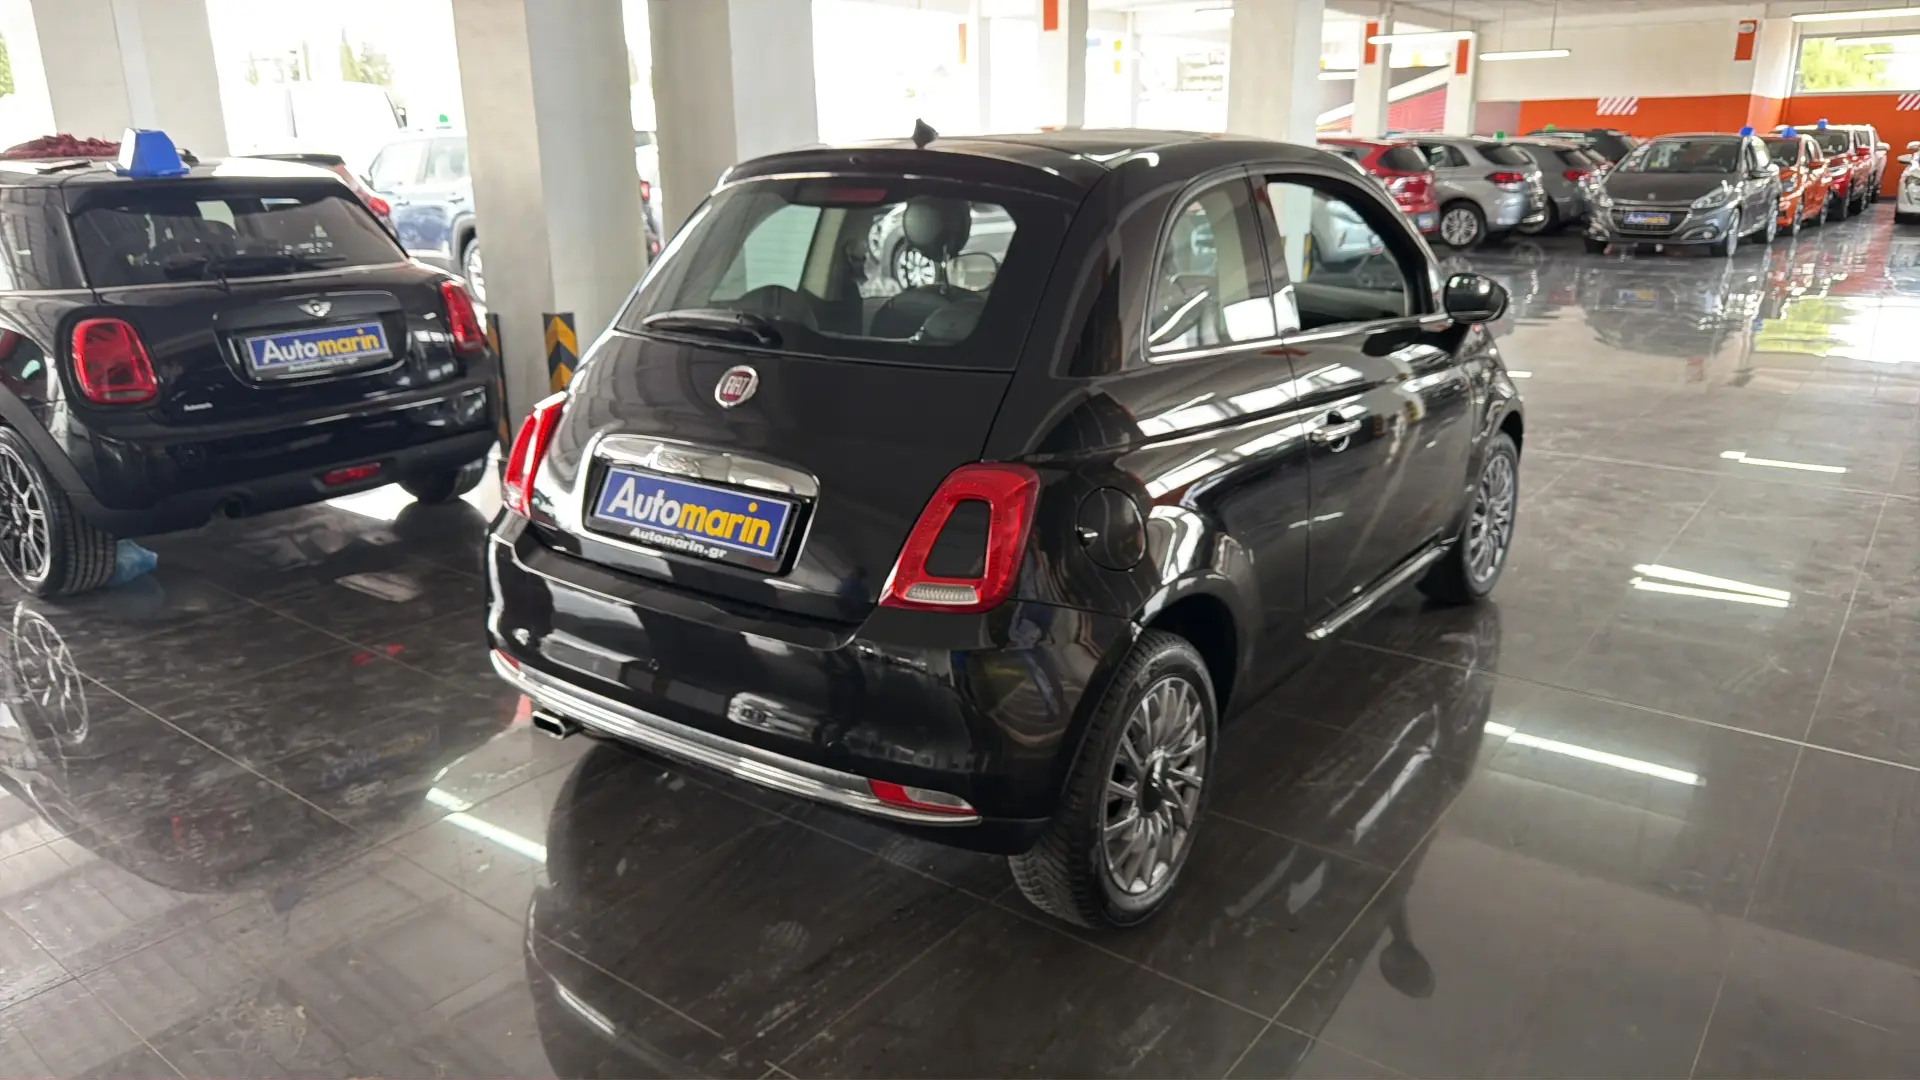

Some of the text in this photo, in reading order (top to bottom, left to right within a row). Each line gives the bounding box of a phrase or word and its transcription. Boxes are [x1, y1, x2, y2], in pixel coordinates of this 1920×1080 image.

[263, 329, 379, 364] Automarin
[722, 375, 750, 396] FIAT
[607, 477, 771, 547] Automarin
[629, 527, 727, 558] Automarin.gr
